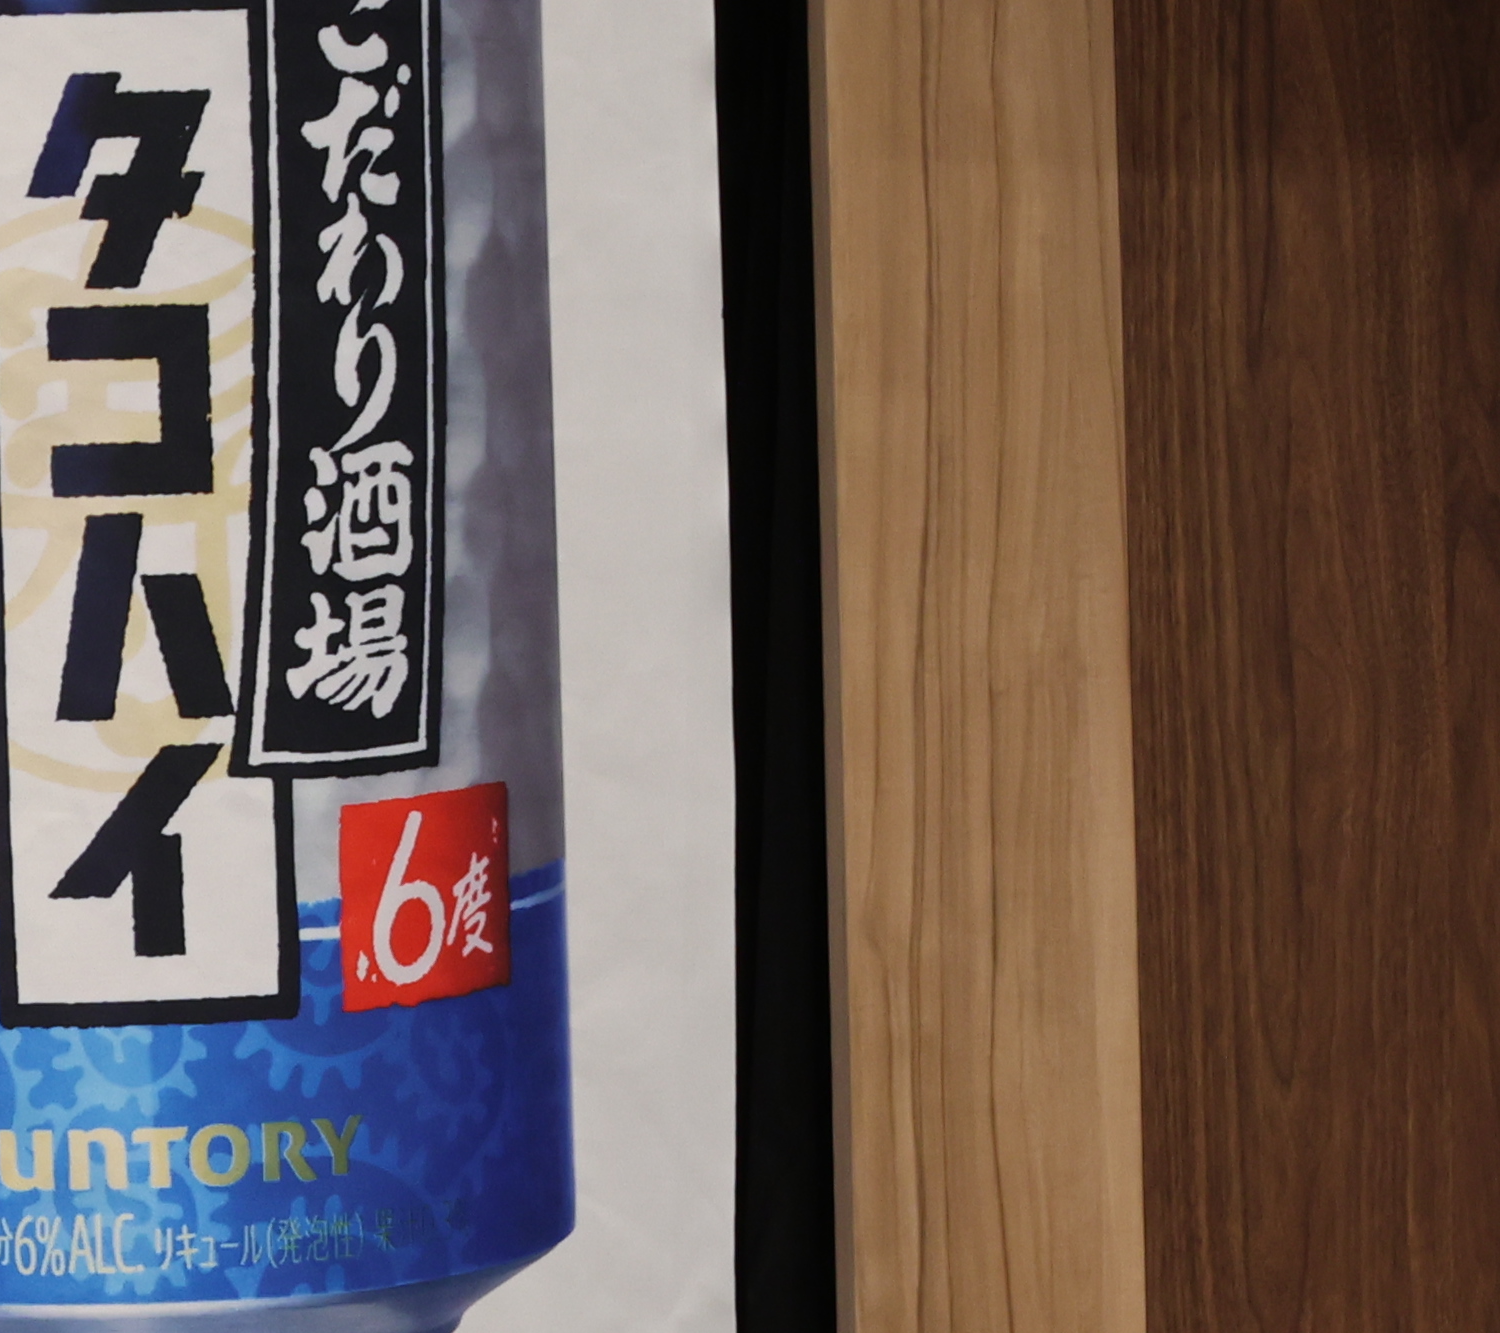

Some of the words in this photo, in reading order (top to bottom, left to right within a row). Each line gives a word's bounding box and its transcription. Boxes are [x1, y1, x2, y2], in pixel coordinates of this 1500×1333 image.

[24, 70, 236, 958] タコハイ
[285, 0, 414, 720] こだわり酒場
[373, 812, 496, 986] 6度
